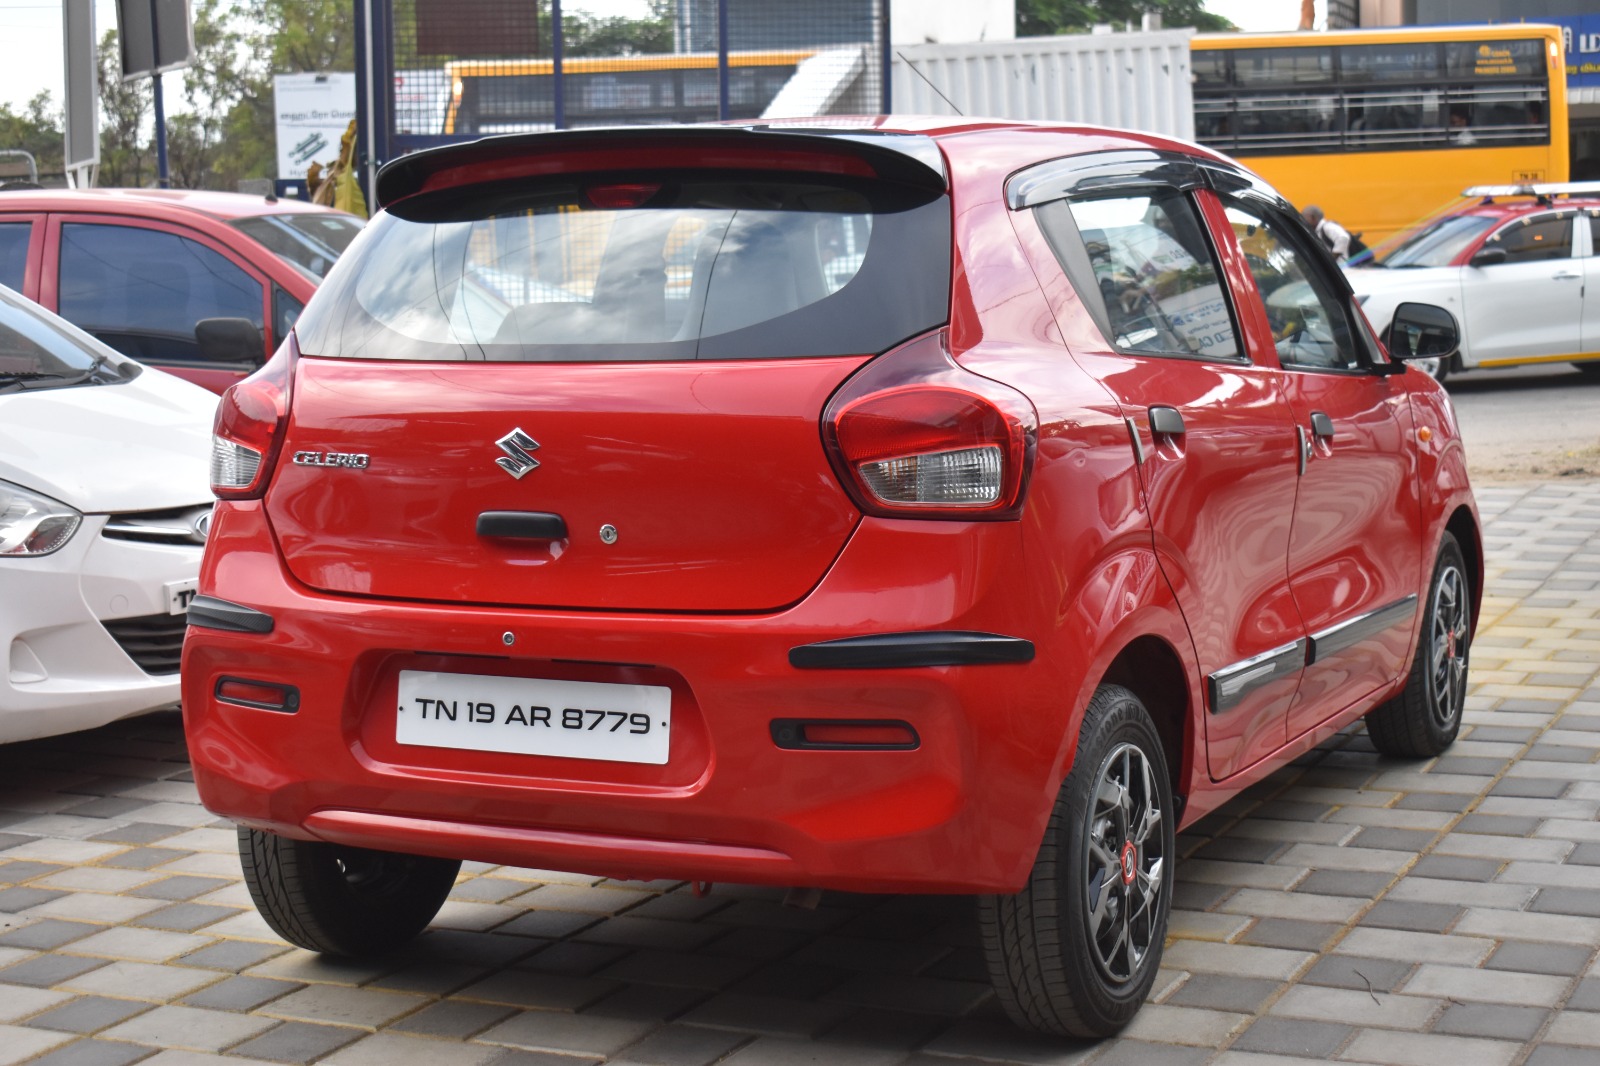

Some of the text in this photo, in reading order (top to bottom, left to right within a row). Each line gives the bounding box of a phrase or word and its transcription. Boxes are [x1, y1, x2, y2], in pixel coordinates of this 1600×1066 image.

[292, 450, 370, 469] CELERIO
[416, 697, 652, 735] TN 19 AR 8779
